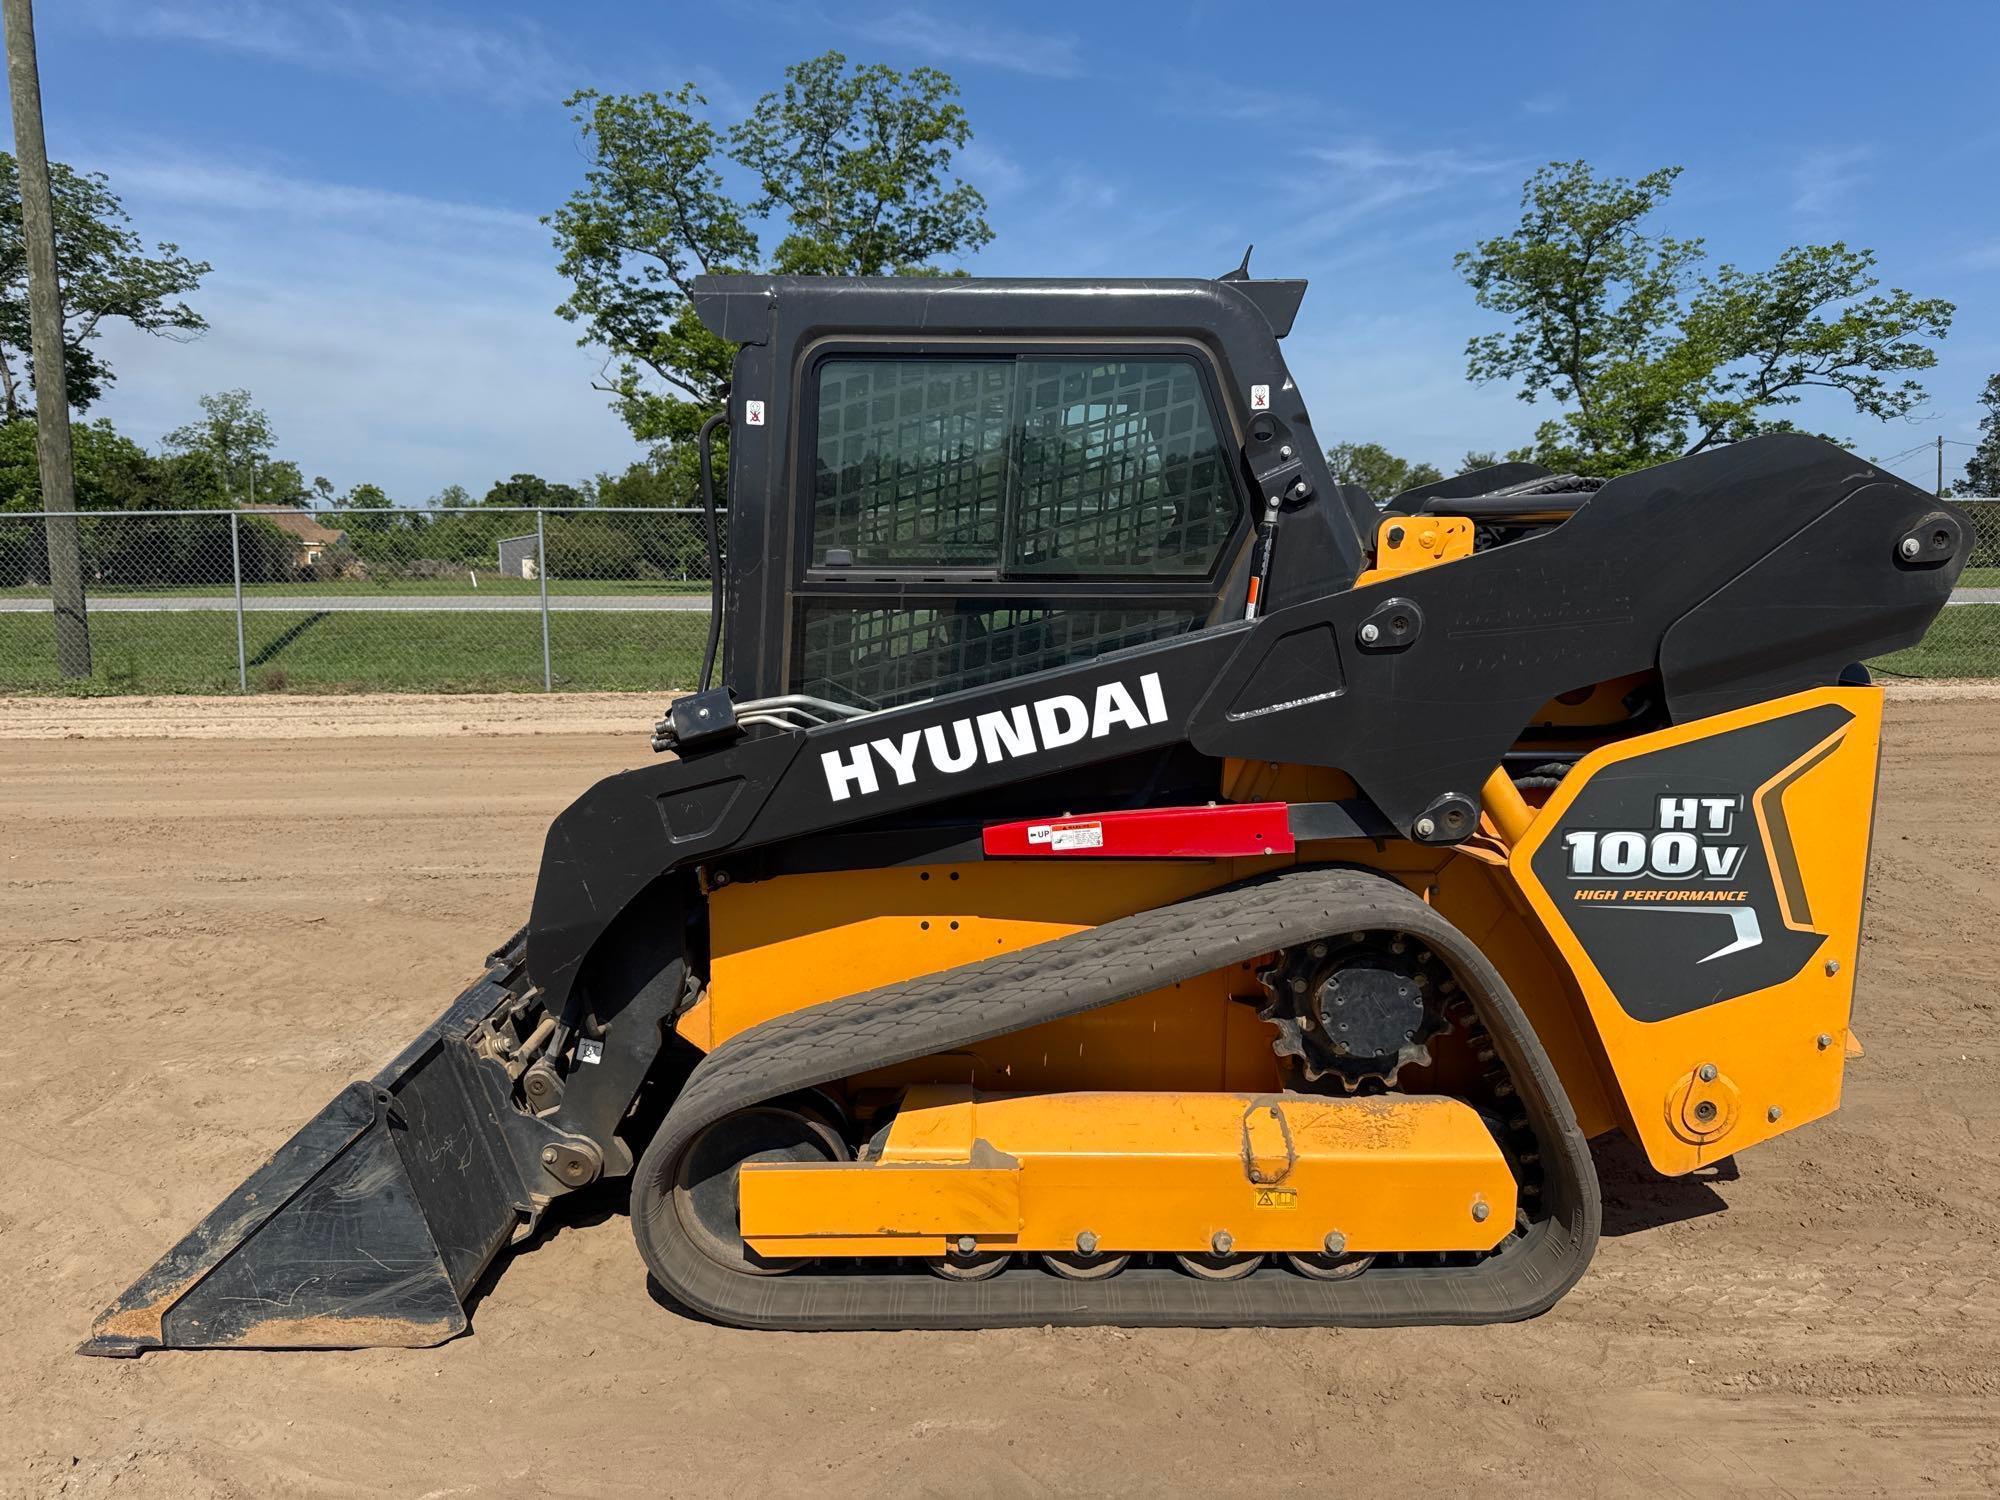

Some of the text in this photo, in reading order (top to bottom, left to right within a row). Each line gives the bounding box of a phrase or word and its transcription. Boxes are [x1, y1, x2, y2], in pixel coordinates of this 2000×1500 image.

[821, 672, 1169, 802] HYUNDAI
[1659, 797, 1736, 829] HT
[1037, 830, 1050, 838] UP
[1574, 890, 1619, 901] HIGH
[1622, 890, 1749, 901] PERFORMANCE
